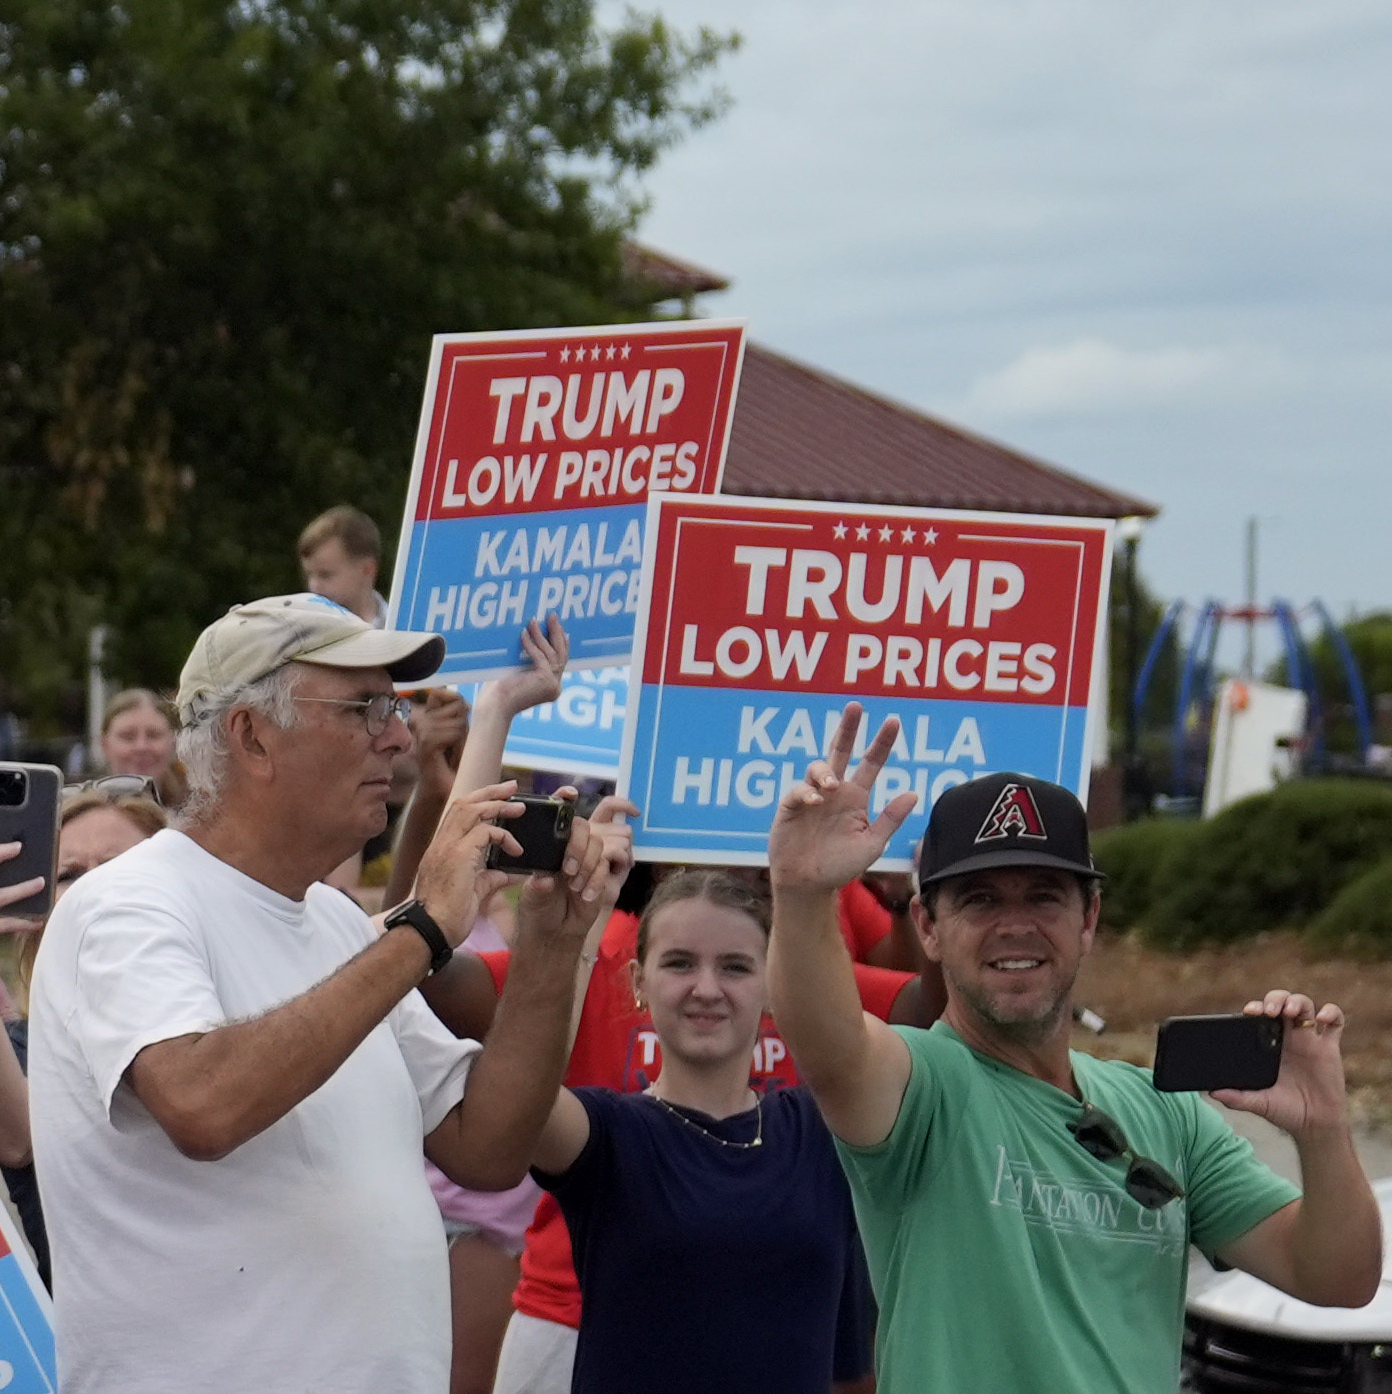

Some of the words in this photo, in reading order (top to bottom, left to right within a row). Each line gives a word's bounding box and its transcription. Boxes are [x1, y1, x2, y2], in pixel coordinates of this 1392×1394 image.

[488, 367, 684, 445] TRUMP
[442, 453, 549, 508] LOW
[554, 441, 701, 498] PRICES
[474, 518, 642, 578] KAMALA
[425, 579, 529, 632] HIGH
[537, 568, 640, 624] PRICE
[733, 546, 1025, 629] TRUMP
[679, 623, 829, 683] LOW
[844, 633, 1057, 695] PRICES
